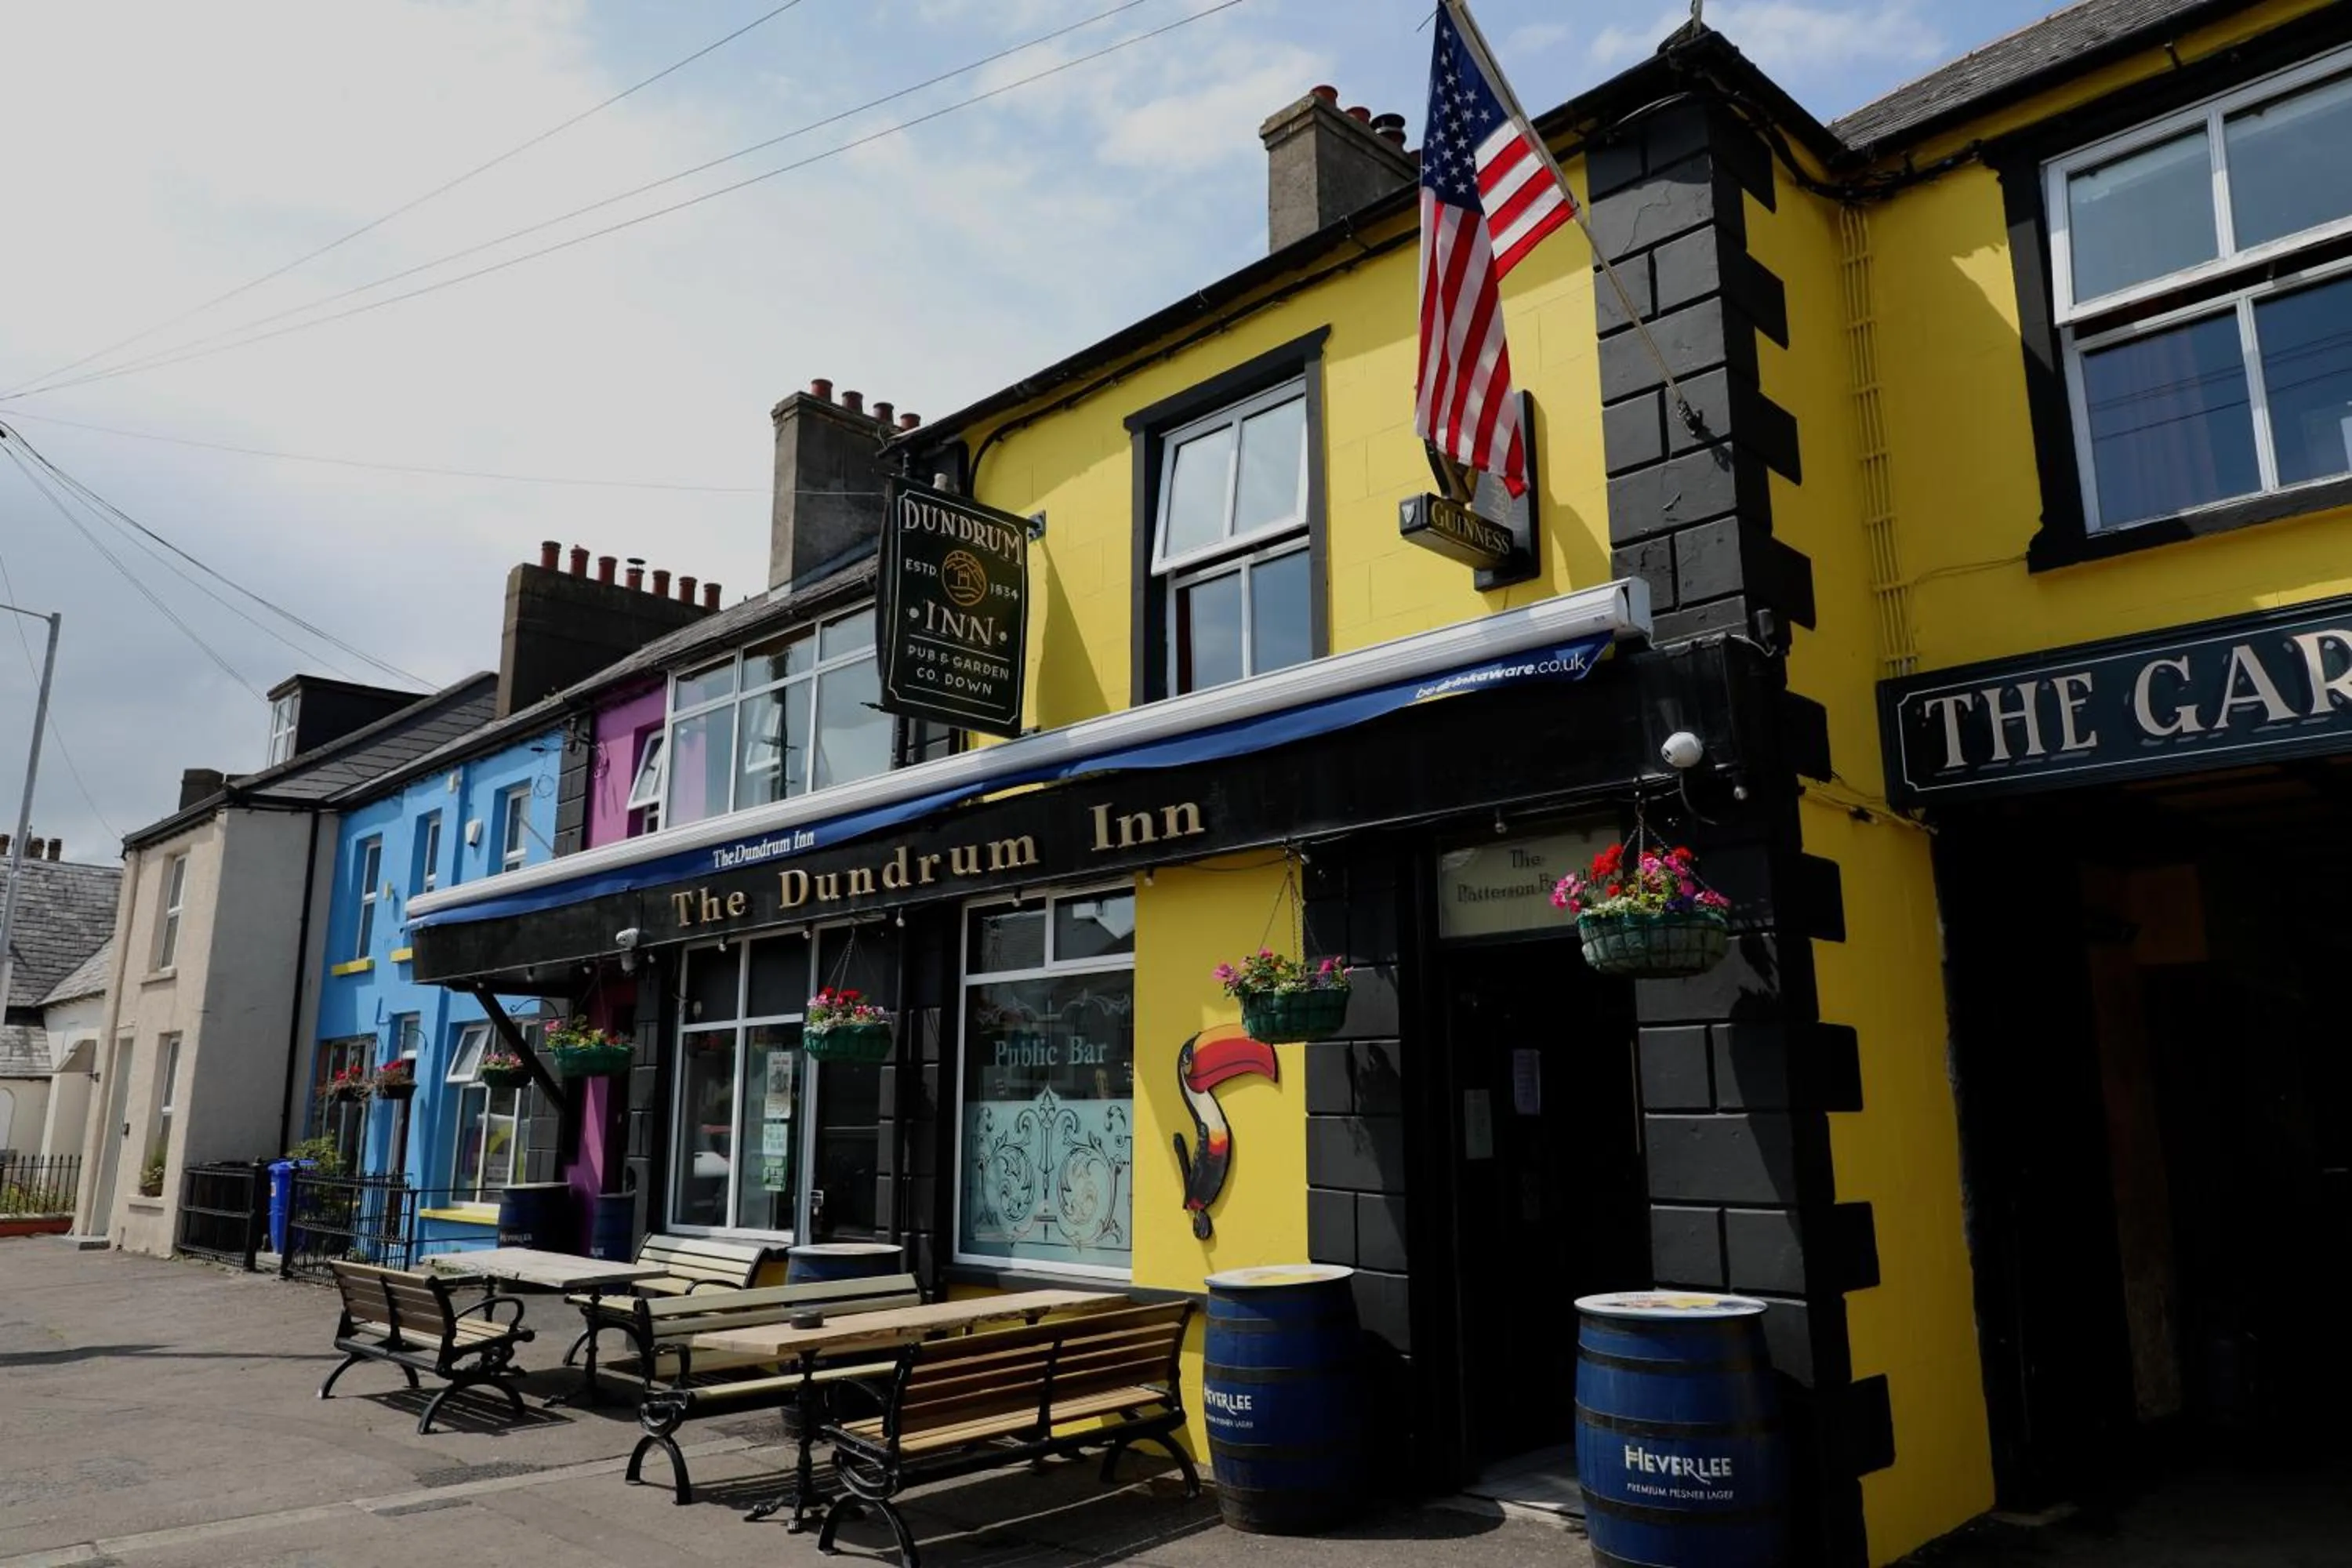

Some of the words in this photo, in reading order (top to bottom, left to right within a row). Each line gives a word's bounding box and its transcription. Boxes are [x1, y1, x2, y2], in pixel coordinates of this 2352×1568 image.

[904, 499, 1022, 565] DUNDRUM
[1432, 501, 1510, 554] GUINNESS
[924, 601, 994, 647] INN
[908, 644, 935, 662] PUB
[953, 656, 1010, 681] GARDEN
[916, 667, 939, 684] CO.
[945, 673, 993, 695] DOWN
[1925, 671, 2098, 770] THE
[2133, 628, 2352, 738] GAR
[670, 886, 749, 928] The
[779, 831, 1040, 910] Dundrum
[1091, 798, 1206, 852] Inn
[713, 849, 734, 869] The
[734, 838, 790, 864] Dundrum
[793, 830, 815, 849] Inn
[1510, 848, 1541, 869] The
[1457, 883, 1536, 903] Patterson
[993, 1039, 1058, 1066] Public
[1067, 1036, 1108, 1065] Bar
[1624, 1444, 1733, 1485] HEVERLEE
[1627, 1483, 1668, 1497] PREMIUM
[1669, 1487, 1705, 1501] PILSNER
[1707, 1490, 1734, 1501] LAGER
